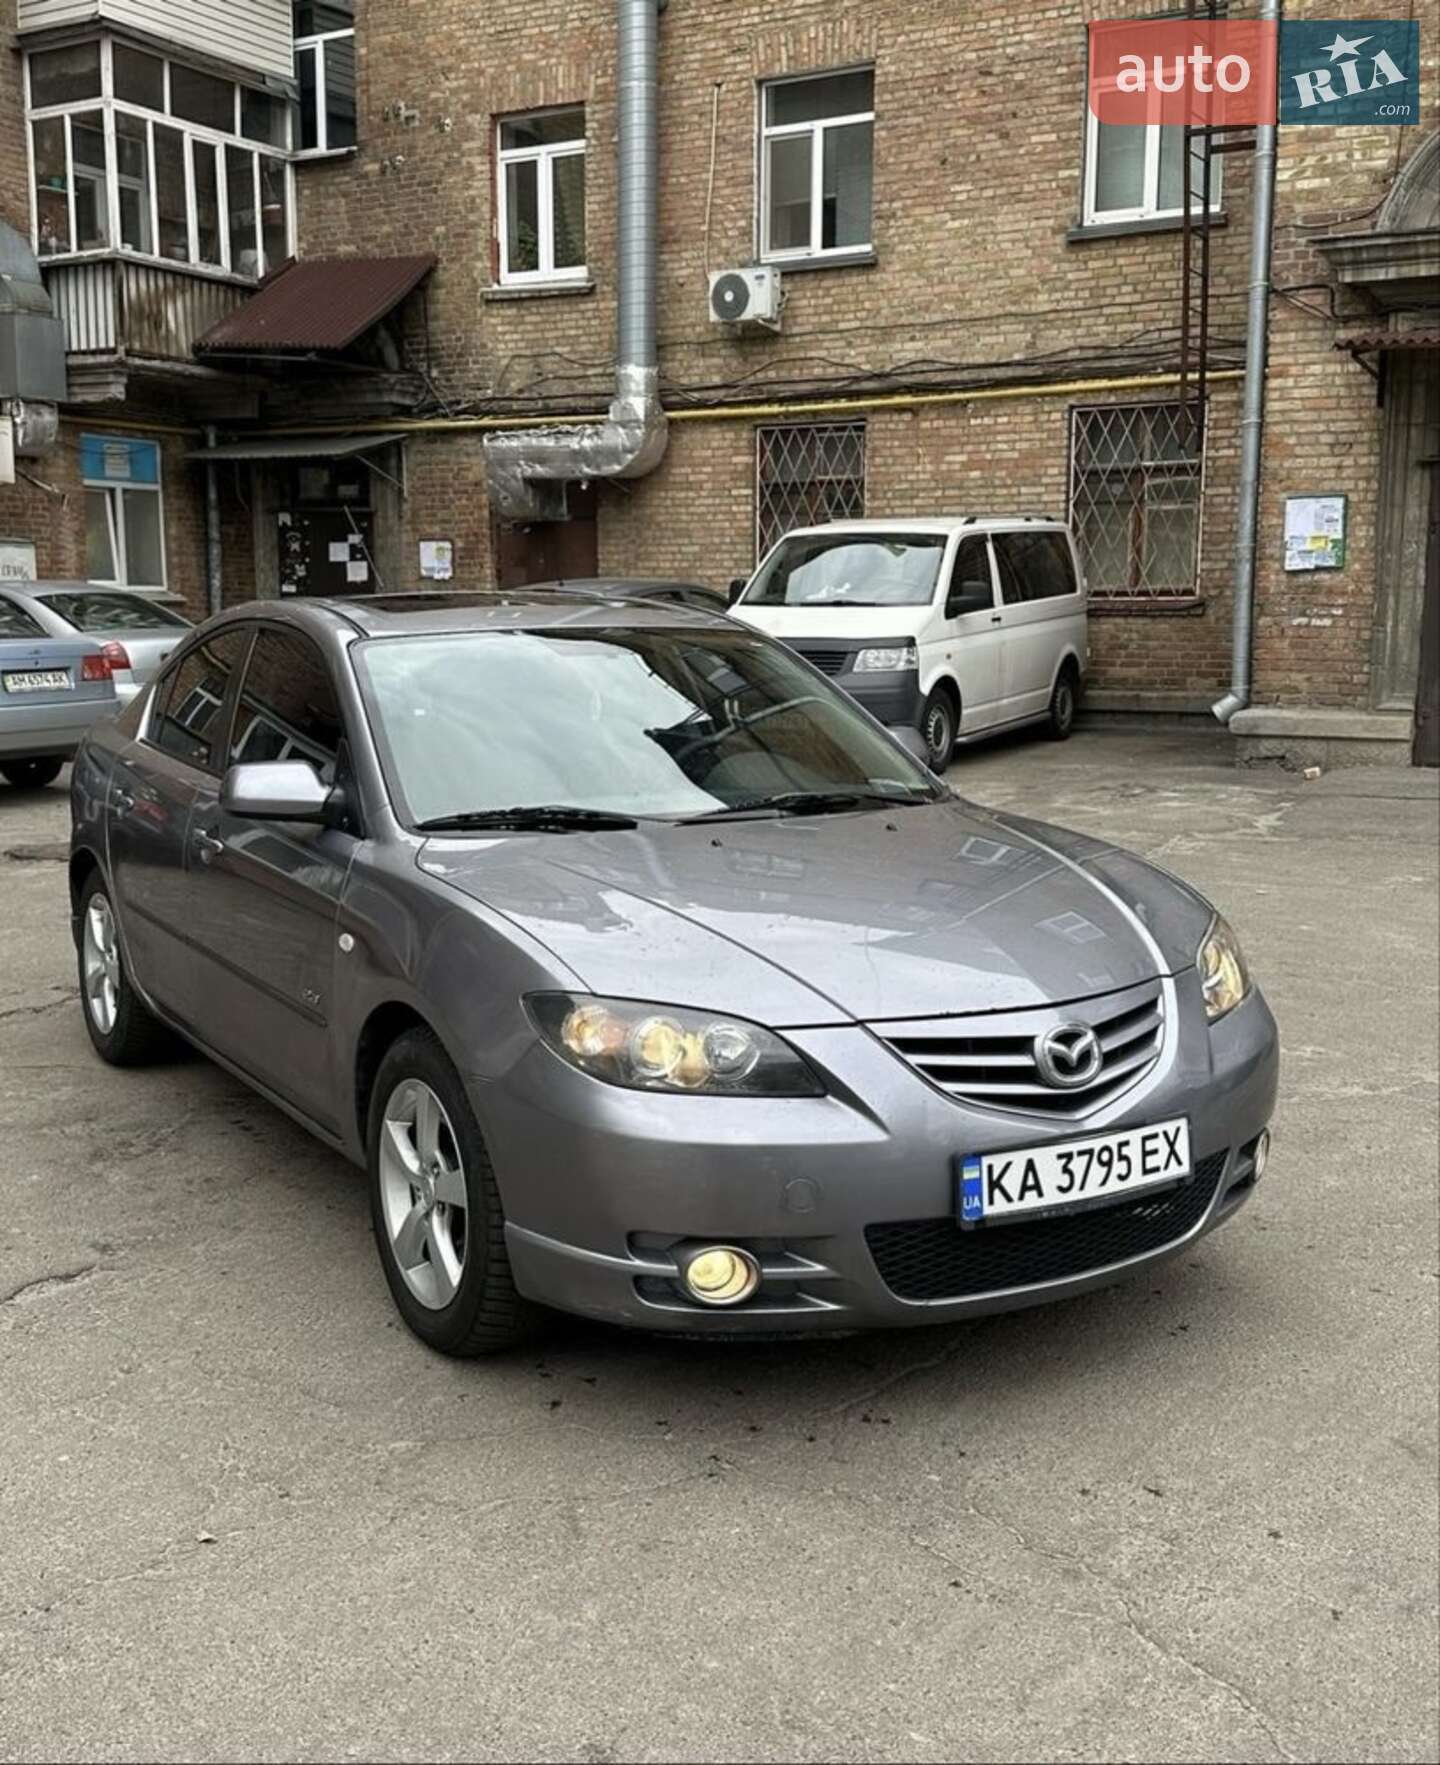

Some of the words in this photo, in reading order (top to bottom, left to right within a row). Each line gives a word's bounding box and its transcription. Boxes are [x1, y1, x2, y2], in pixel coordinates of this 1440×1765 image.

[986, 1158, 1045, 1206] KA
[1056, 1140, 1132, 1194] 3795
[1141, 1126, 1184, 1177] EX
[962, 1196, 981, 1210] UA
